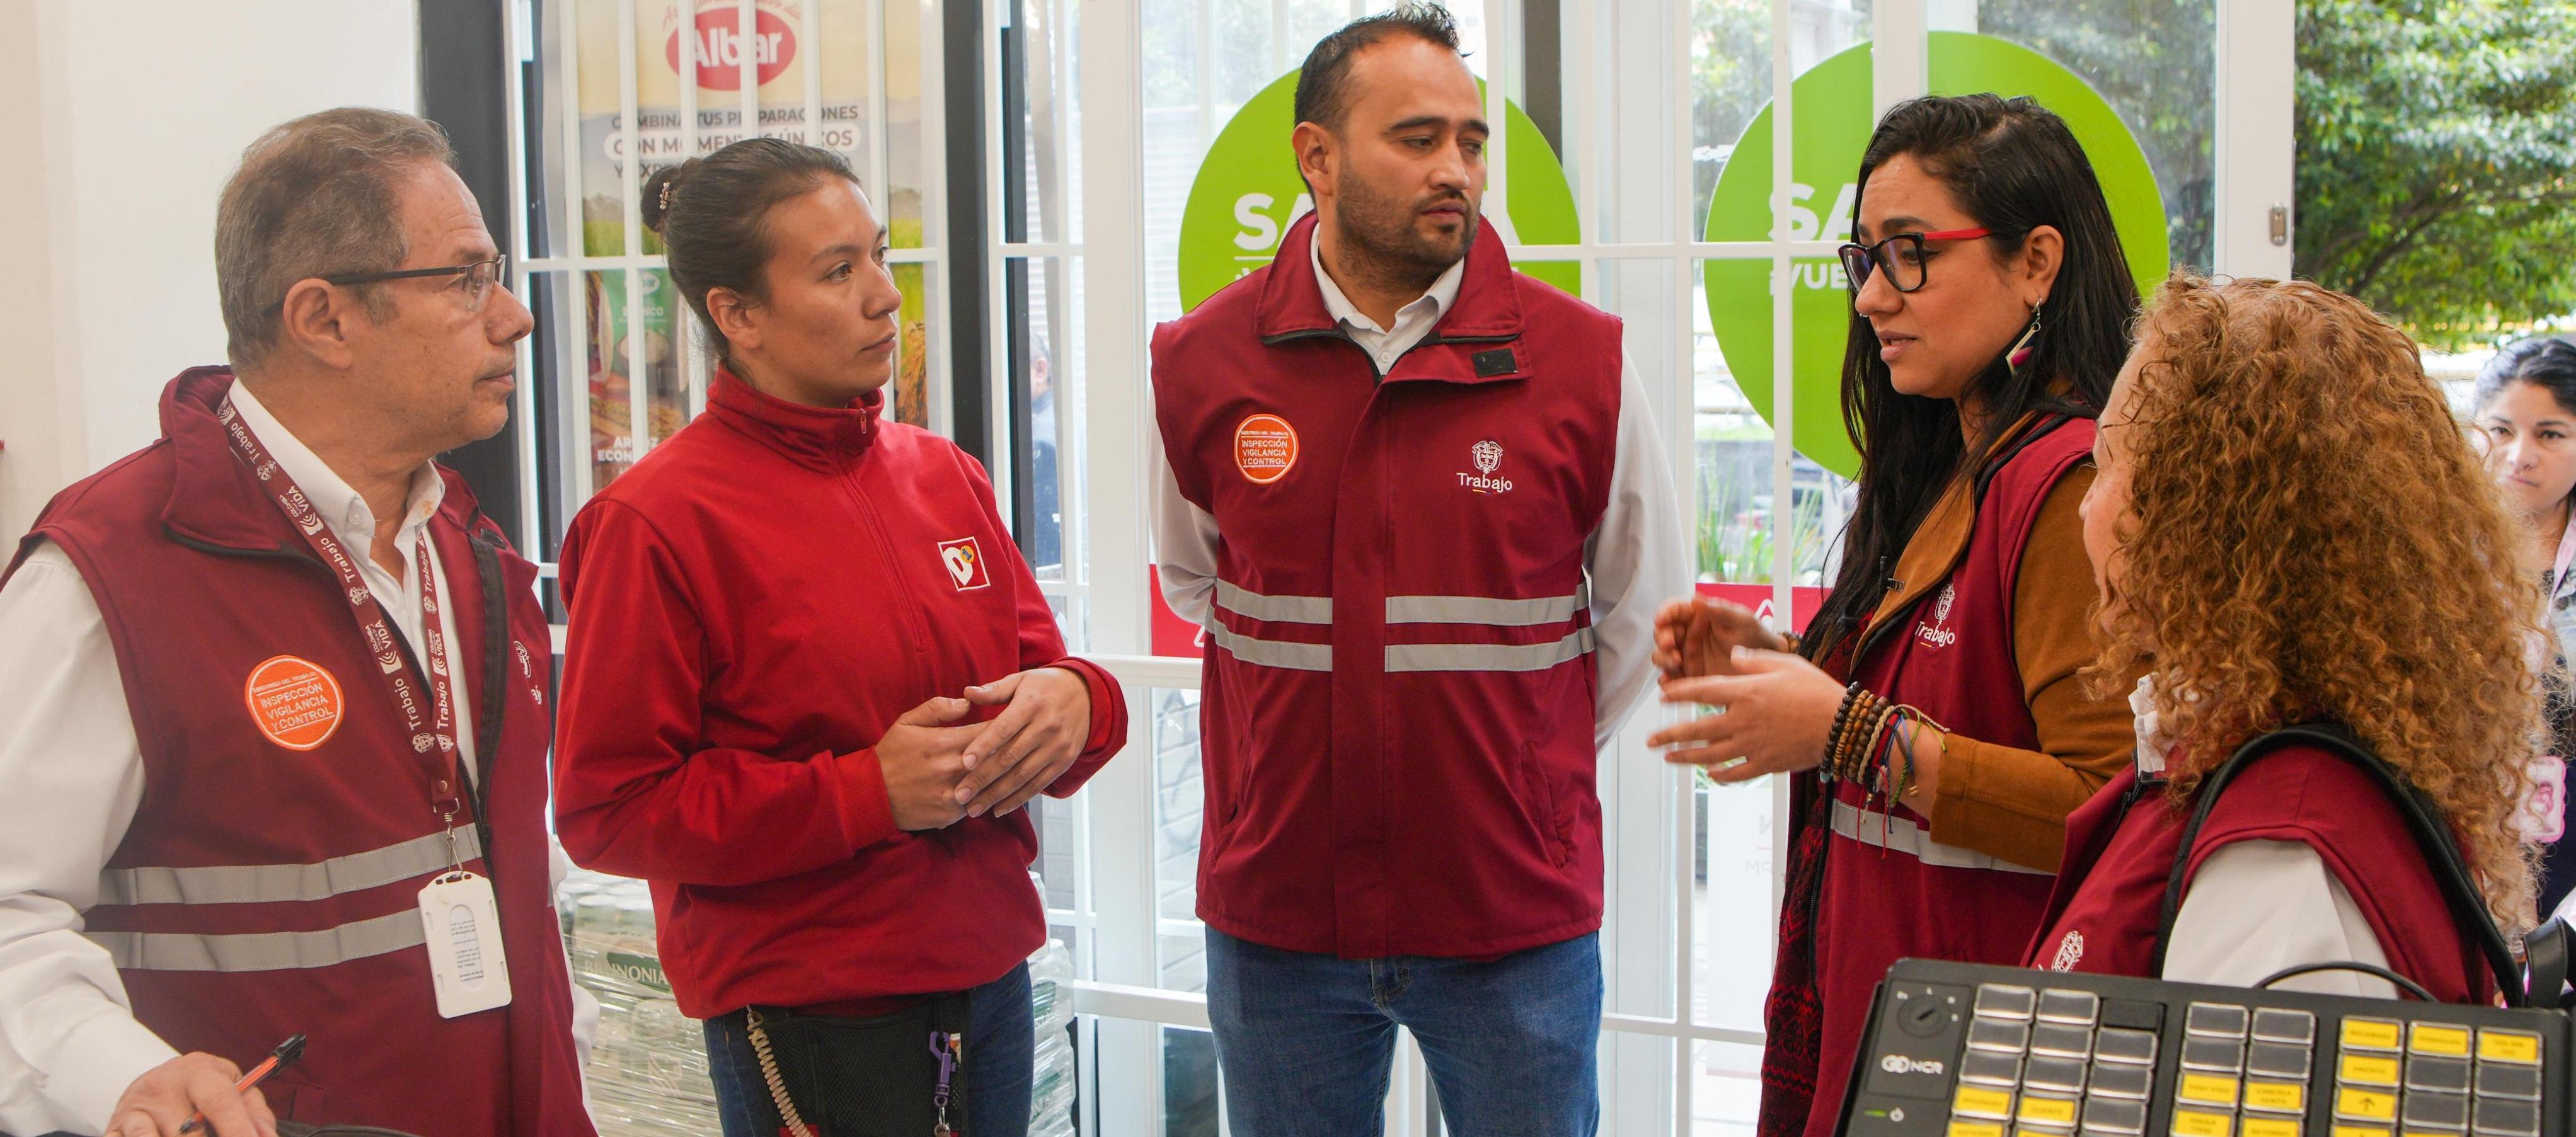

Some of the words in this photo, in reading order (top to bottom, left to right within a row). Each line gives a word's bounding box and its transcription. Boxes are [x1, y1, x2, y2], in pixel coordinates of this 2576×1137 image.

[1241, 437, 1287, 448] INSPECCIÓN
[1242, 449, 1287, 457] VIGILANCIA
[1456, 472, 1513, 493] Trabajo
[288, 486, 309, 512] VIDA
[320, 537, 355, 583] Trabajo
[420, 551, 433, 592] Trabajo
[374, 619, 392, 649] VIDA
[435, 633, 444, 656] VIDA
[1915, 621, 1956, 648] Trabajo
[260, 681, 323, 709] INSPECCIÓN
[265, 694, 328, 720] VIGILANCIA
[394, 678, 422, 731] Trabajo
[437, 682, 449, 729] Trabajo
